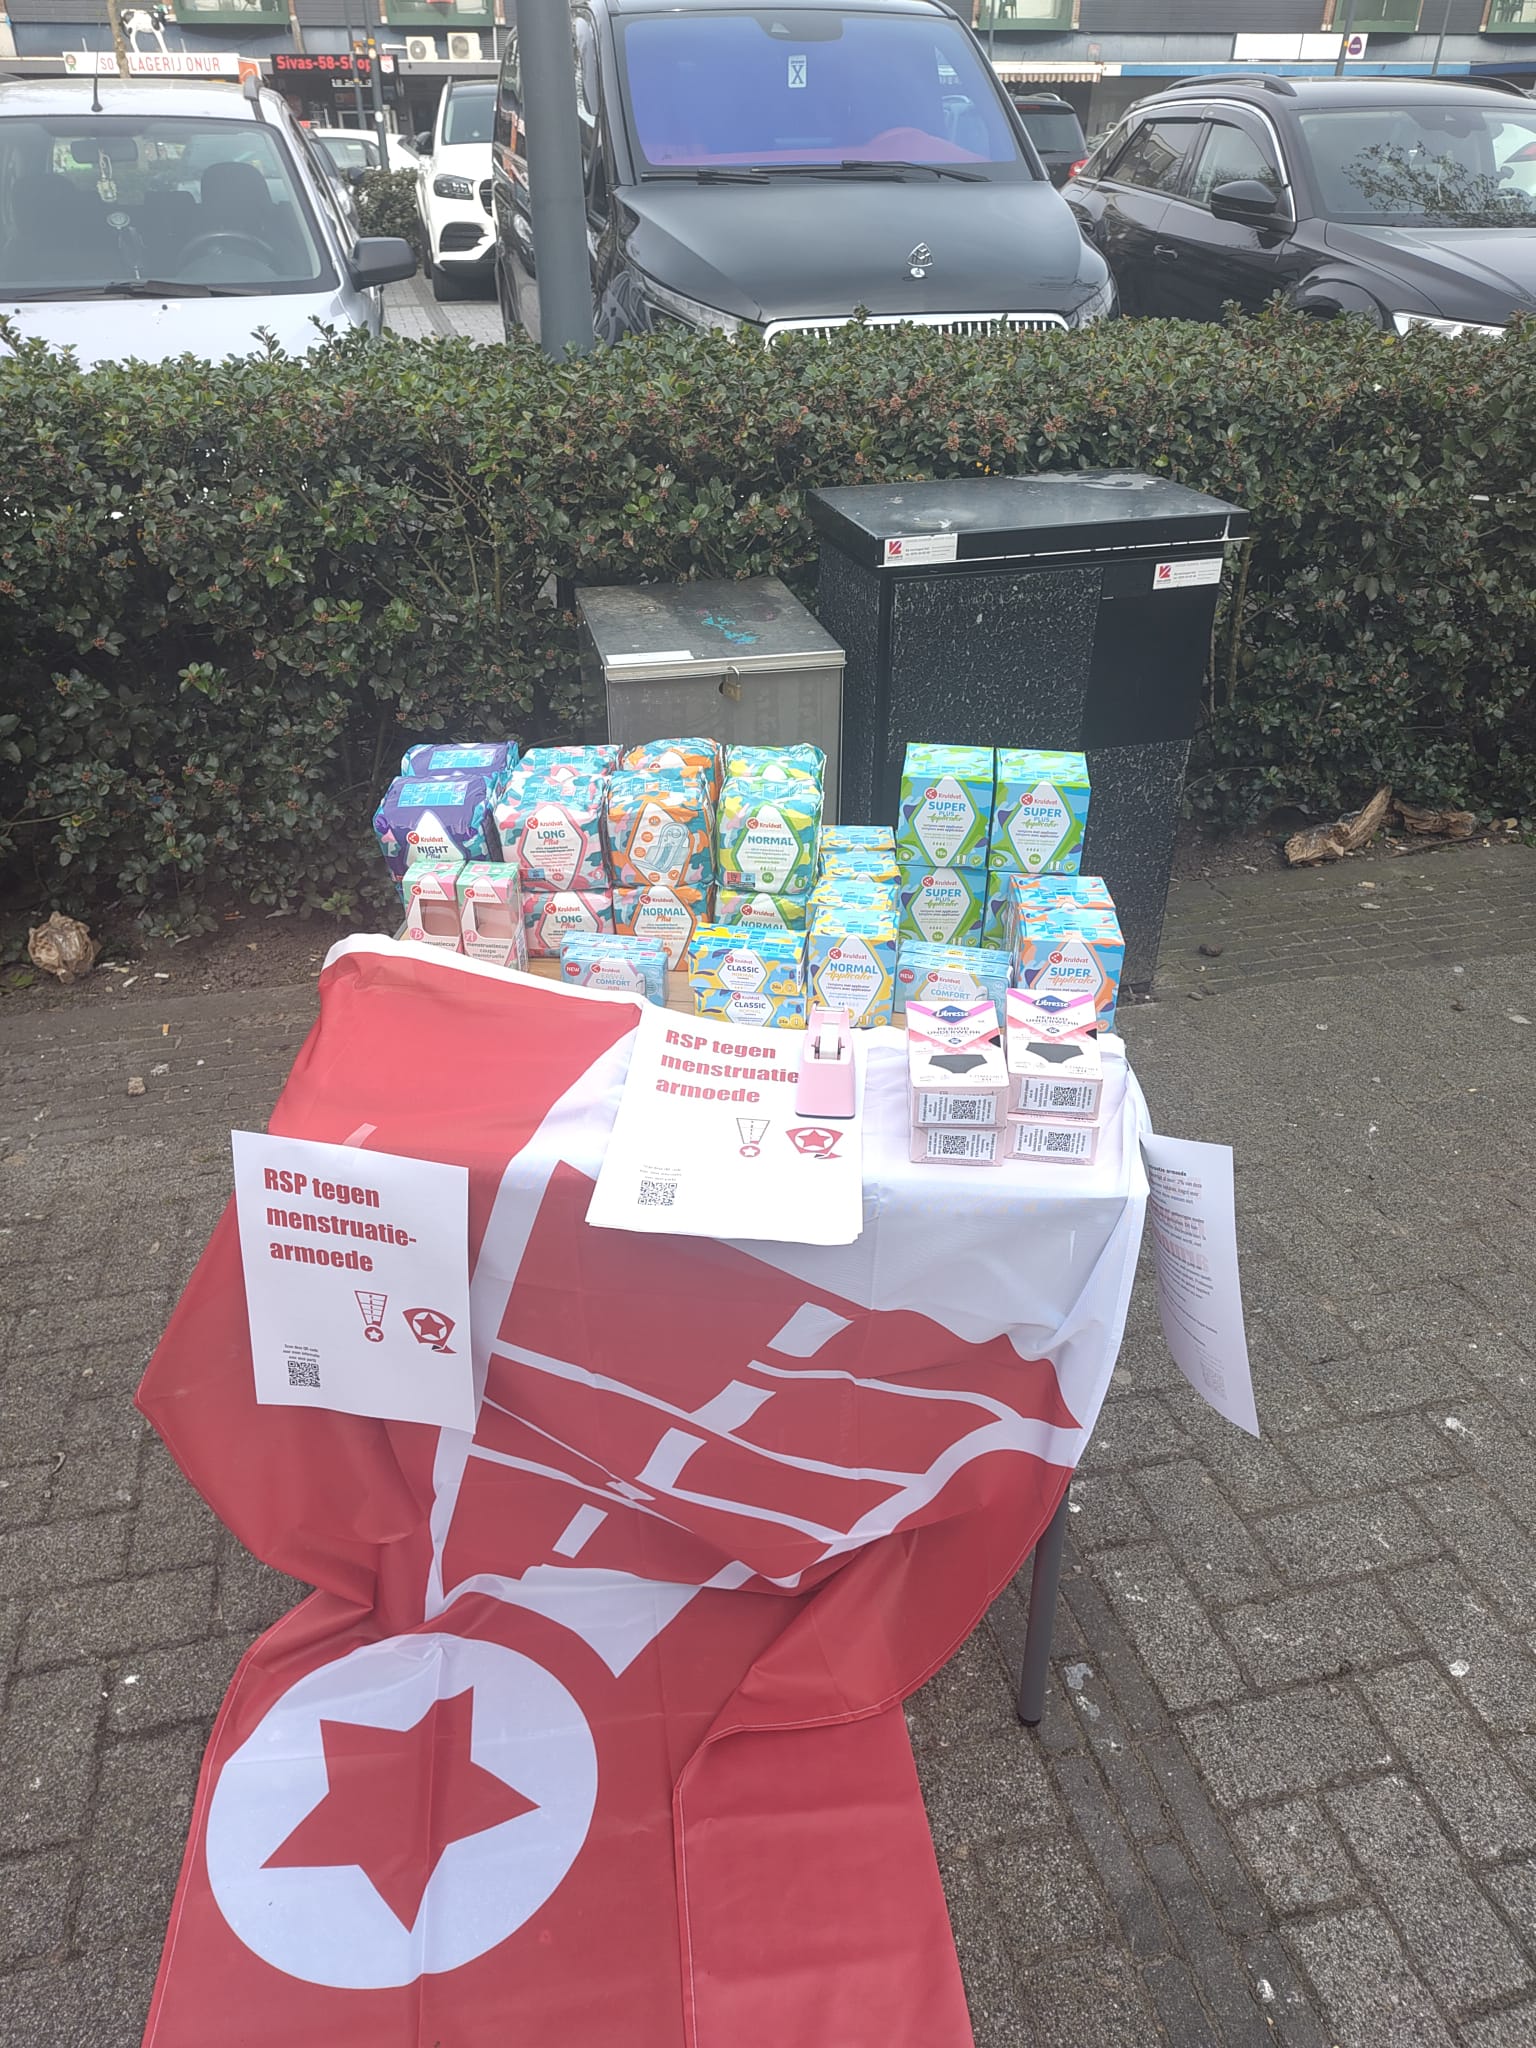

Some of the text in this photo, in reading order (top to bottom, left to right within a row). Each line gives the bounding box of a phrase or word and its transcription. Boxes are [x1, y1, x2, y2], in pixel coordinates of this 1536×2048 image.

[129, 56, 182, 72] LAGERIJ
[186, 57, 221, 72] ONUR
[929, 801, 966, 812] SUPER
[1024, 807, 1062, 818] SUPER
[537, 830, 566, 840] LONG
[748, 836, 794, 846] NORMAL
[417, 845, 448, 854] NIGHT
[925, 888, 962, 896] SUPER
[642, 908, 686, 916] NORMAL
[727, 964, 760, 974] CLASSIC
[830, 962, 878, 974] NORMAL
[1050, 968, 1091, 978] SUPER
[596, 978, 630, 986] COMFORT
[930, 989, 970, 1000] COMFORT
[1035, 1000, 1068, 1008] Libresse
[665, 1029, 776, 1060] RSP tegen
[655, 1078, 760, 1103] armoede
[264, 1167, 380, 1208] RSP tegen
[266, 1207, 417, 1246] menstruatie-
[270, 1241, 374, 1272] armoede
